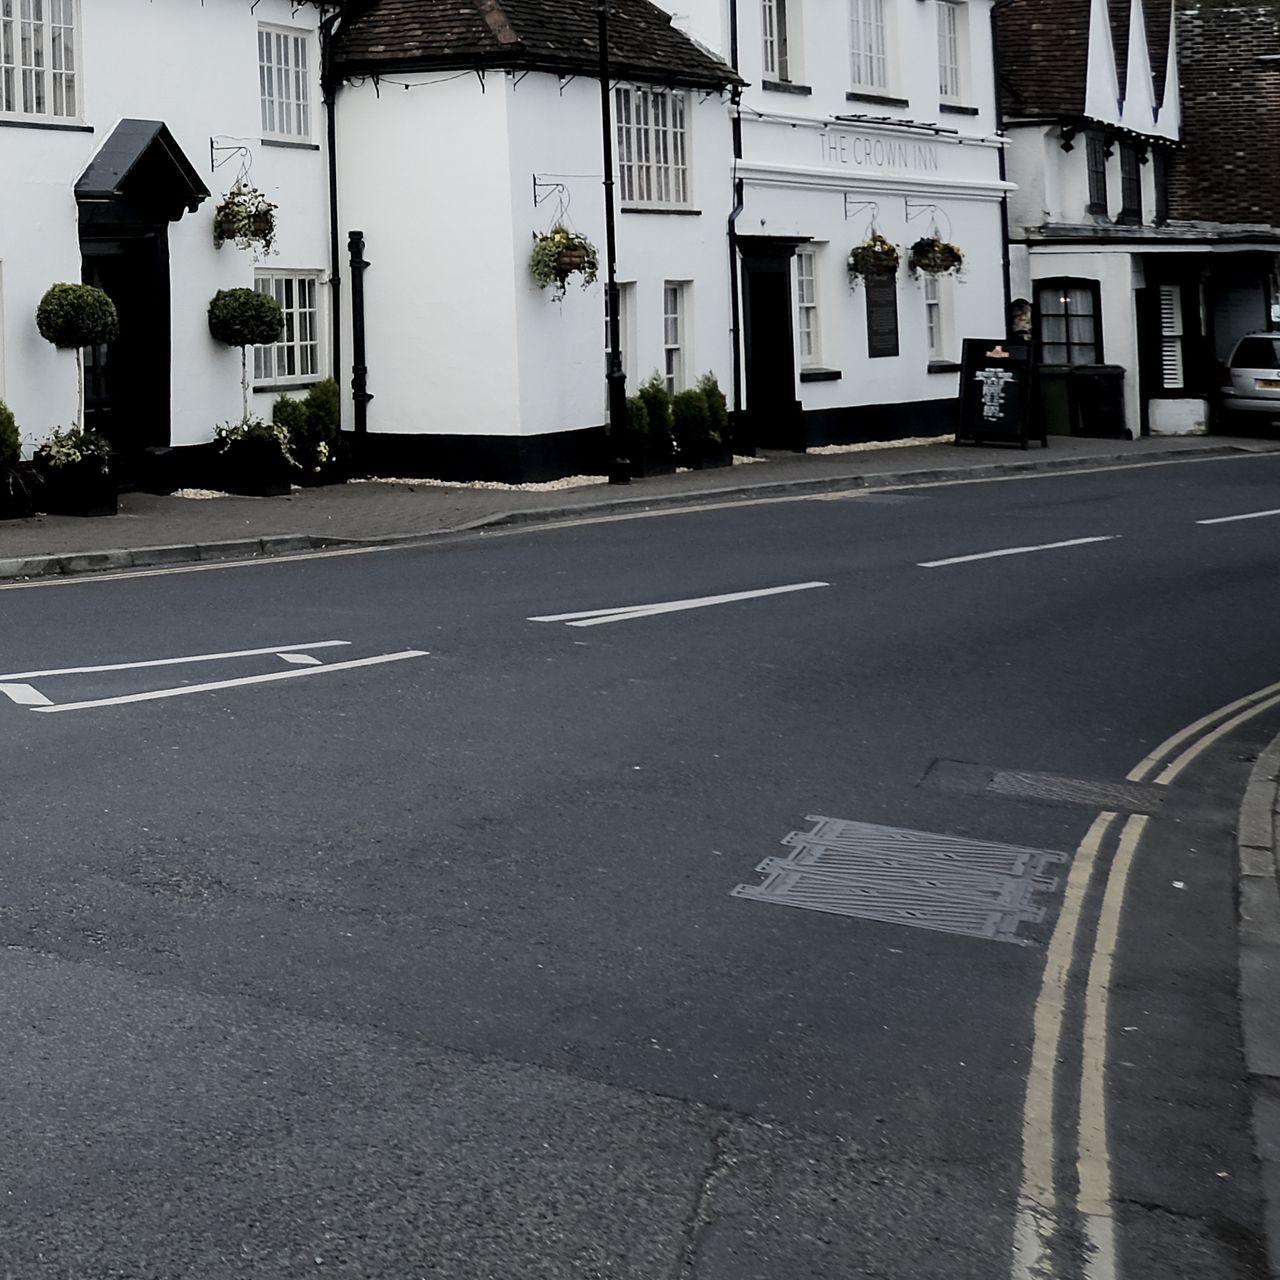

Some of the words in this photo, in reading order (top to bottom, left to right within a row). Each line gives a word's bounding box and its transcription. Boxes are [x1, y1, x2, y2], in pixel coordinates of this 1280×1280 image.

[819, 133, 847, 163] THE
[853, 137, 908, 168] CROWN
[913, 144, 938, 170] INN
